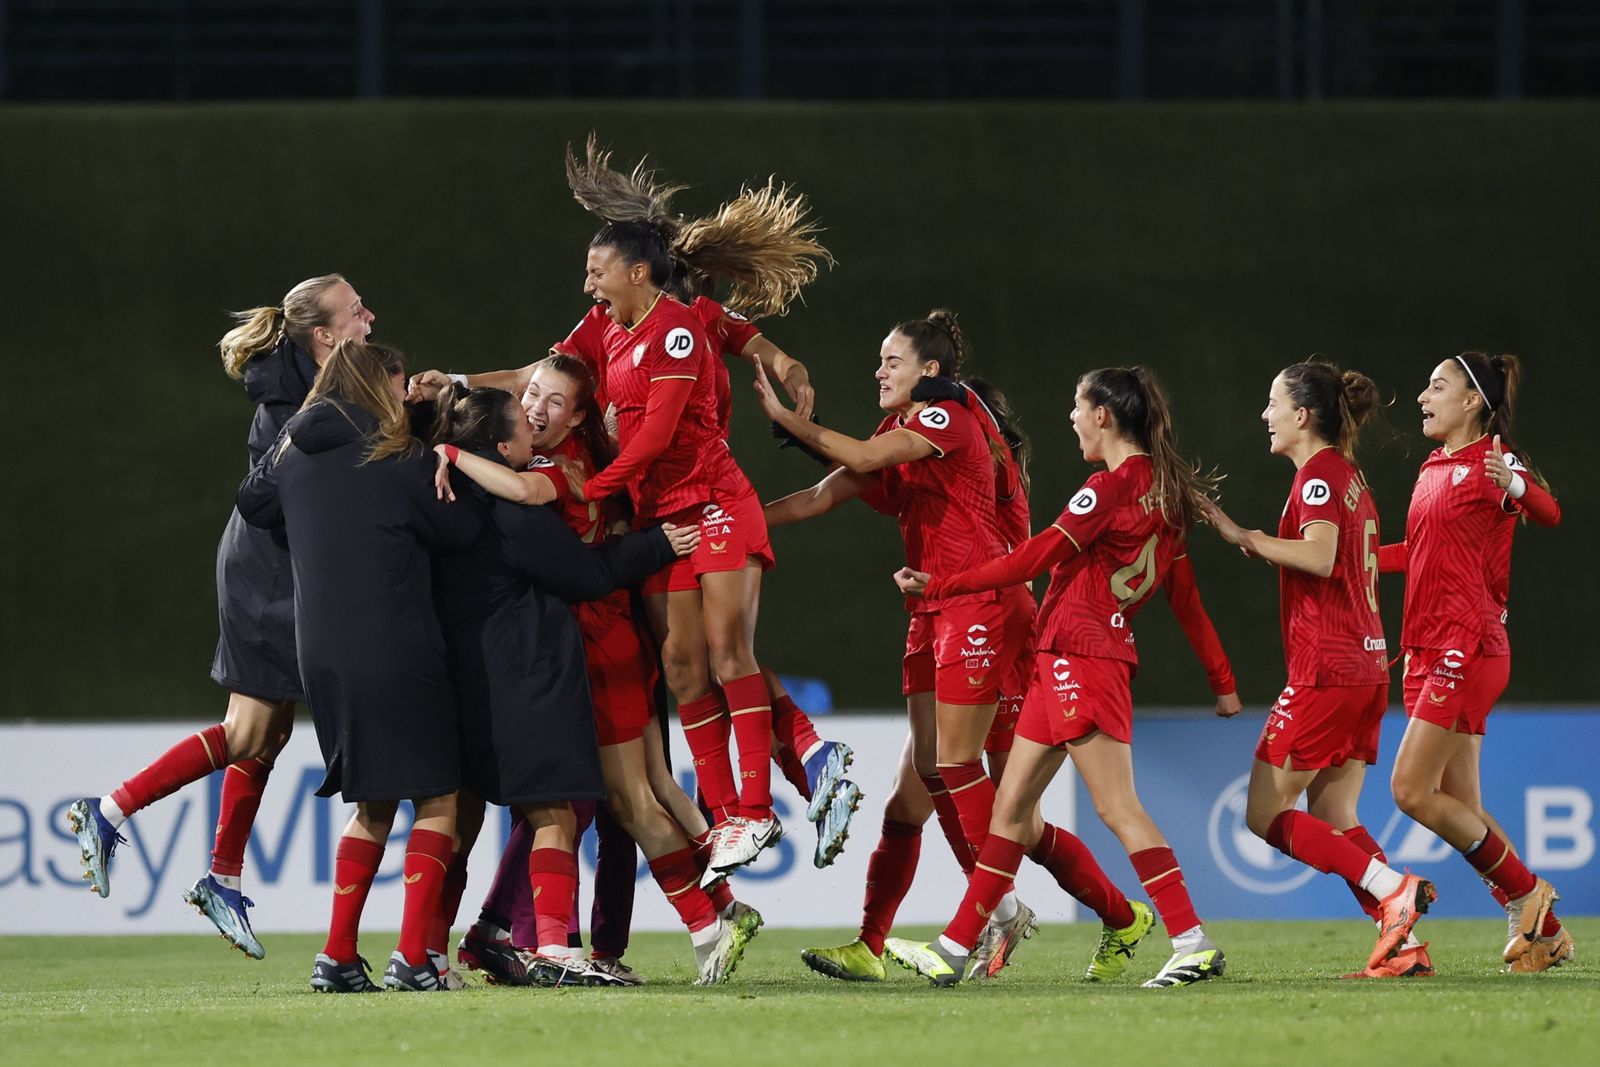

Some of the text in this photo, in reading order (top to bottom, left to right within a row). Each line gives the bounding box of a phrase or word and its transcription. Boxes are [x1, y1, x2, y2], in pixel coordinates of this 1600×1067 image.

[668, 335, 691, 352] JD
[922, 411, 946, 426] JD
[1306, 484, 1327, 500] JD
[1073, 493, 1093, 509] JD
[1110, 533, 1159, 611] 4
[1363, 519, 1377, 613] 5
[1525, 786, 1596, 872] B
